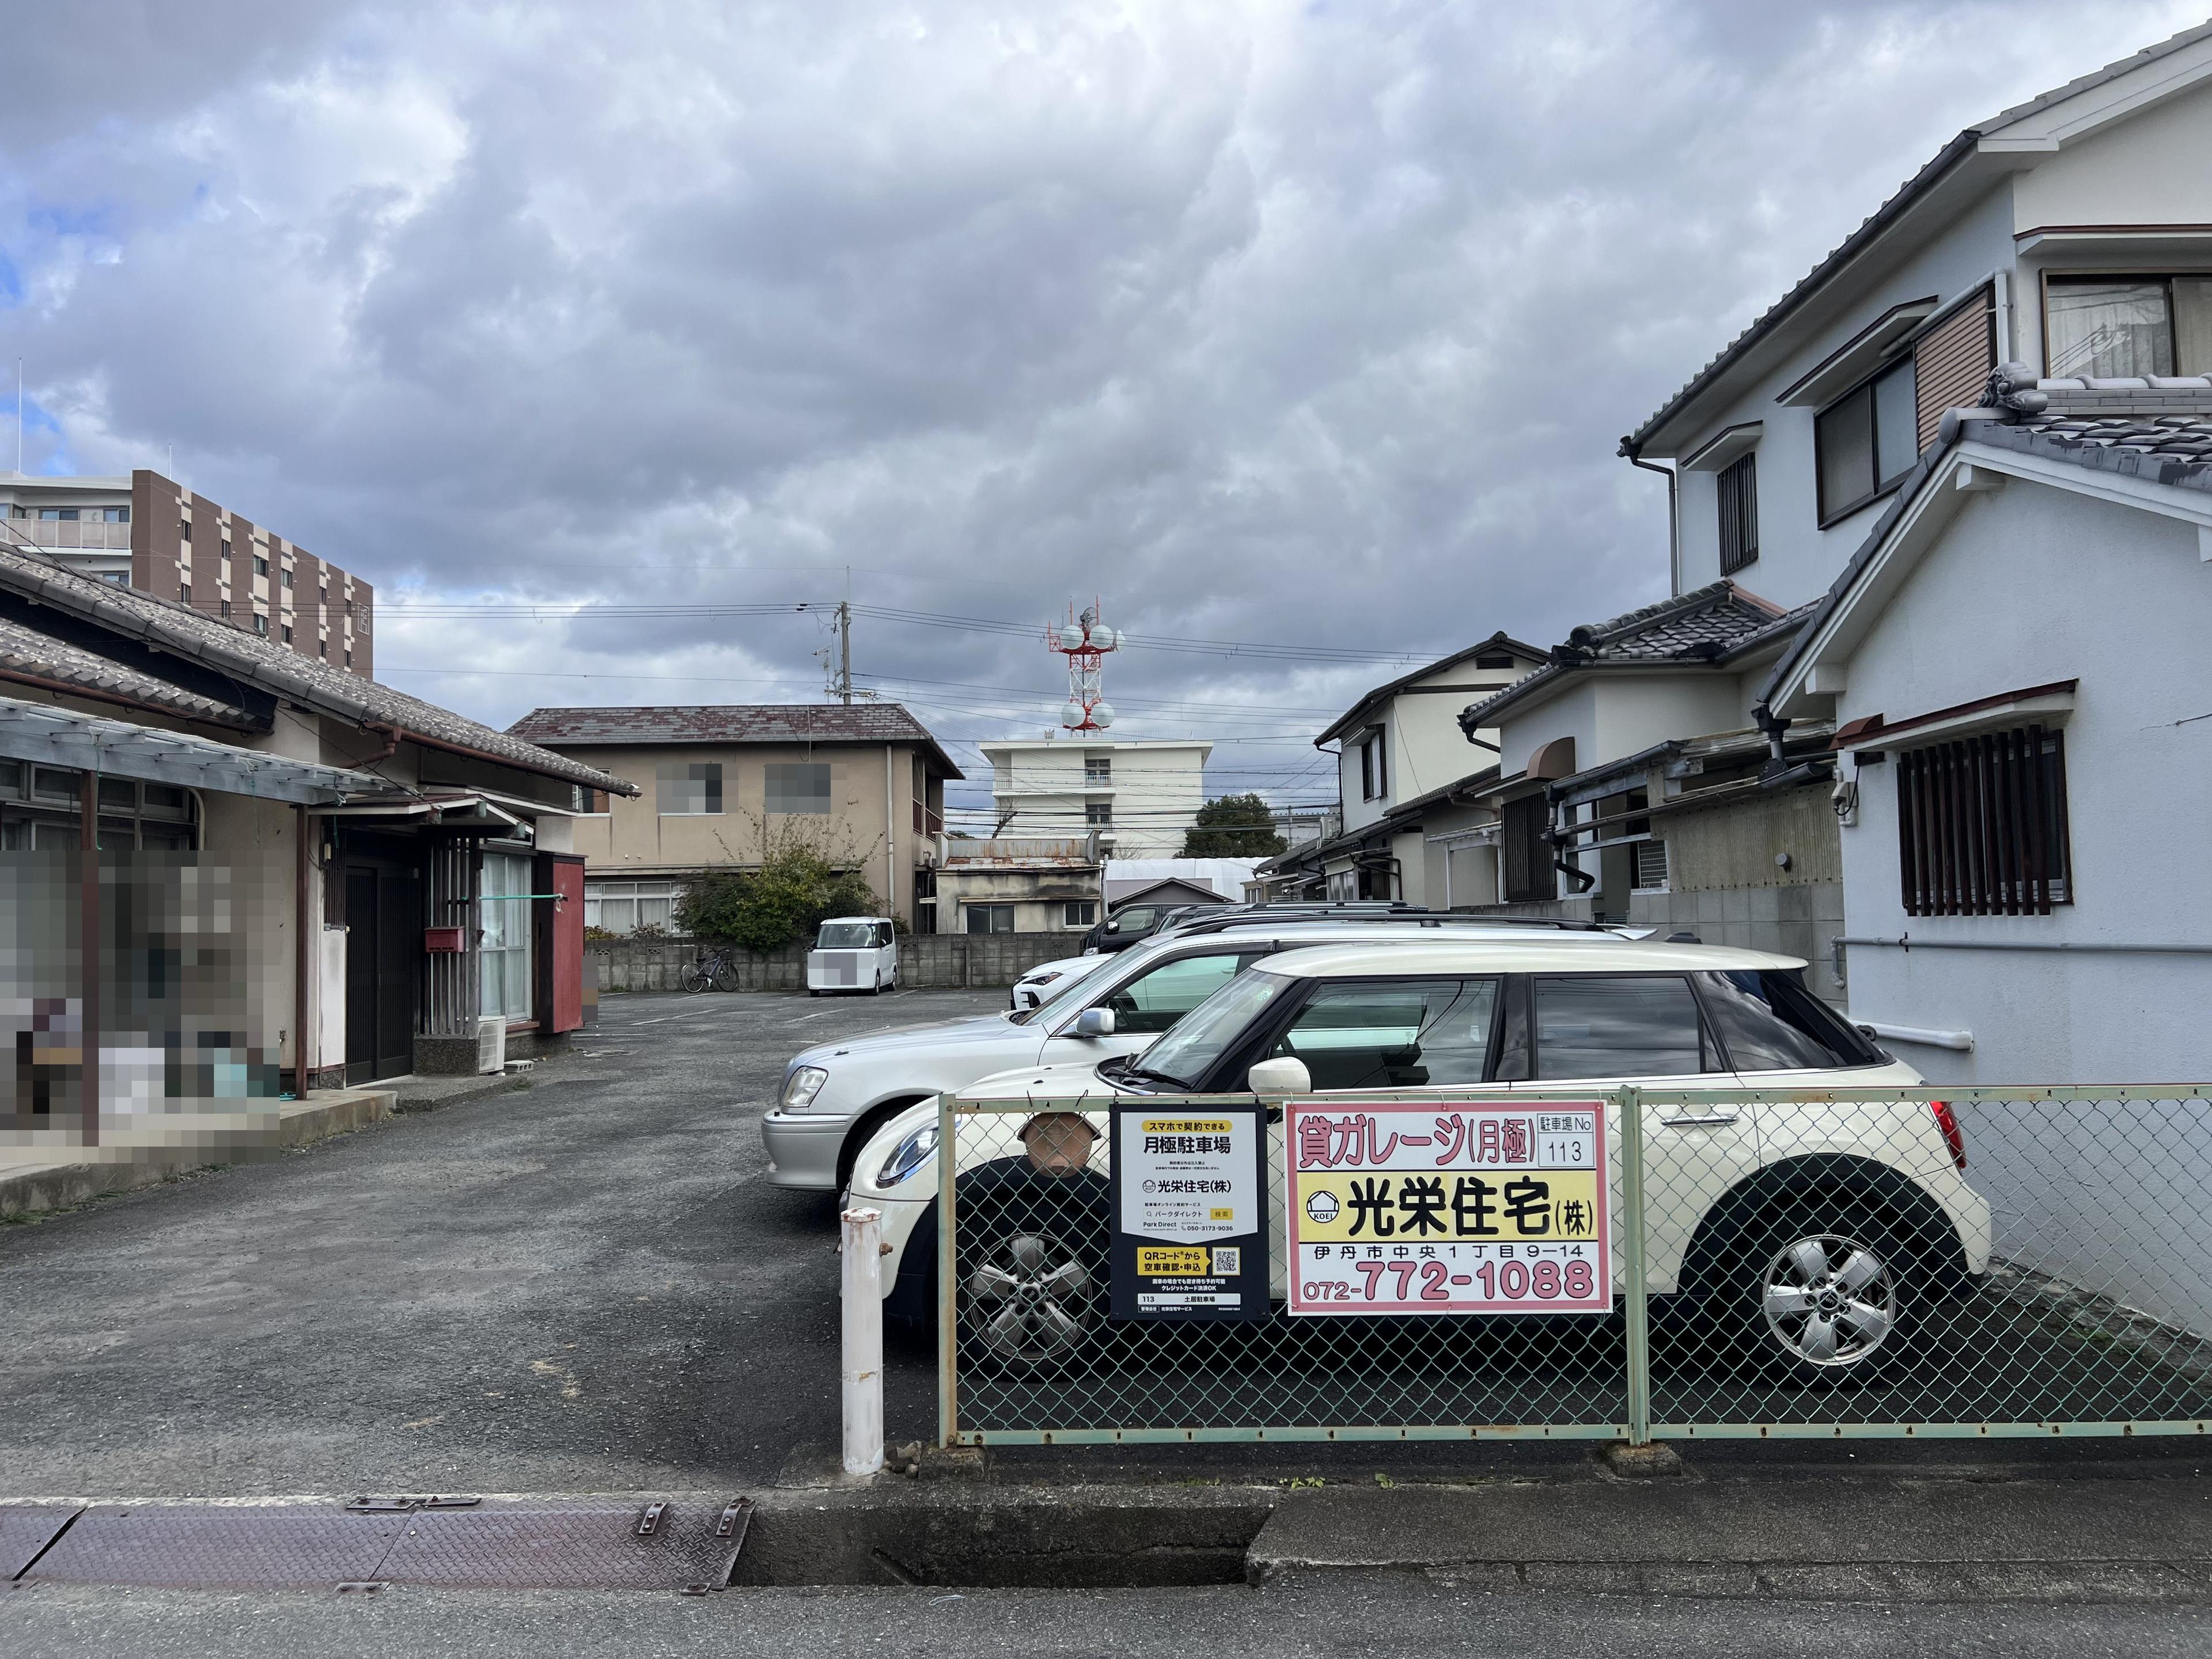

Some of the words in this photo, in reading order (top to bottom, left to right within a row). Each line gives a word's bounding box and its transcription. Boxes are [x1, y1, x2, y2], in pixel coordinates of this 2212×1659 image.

[1149, 1122, 1225, 1131] スマホで契約できる
[1143, 1136, 1231, 1154] 月極駐車場
[1298, 1113, 1535, 1168] 貸ガレージ(月極)
[1548, 1141, 1582, 1162] 113
[1158, 1180, 1231, 1193] 光栄住宅(株)
[1347, 1176, 1593, 1237] 光栄住宅(株)
[1145, 1263, 1200, 1271] 空車確認・申込
[1304, 1260, 1593, 1300] 072-772-1088
